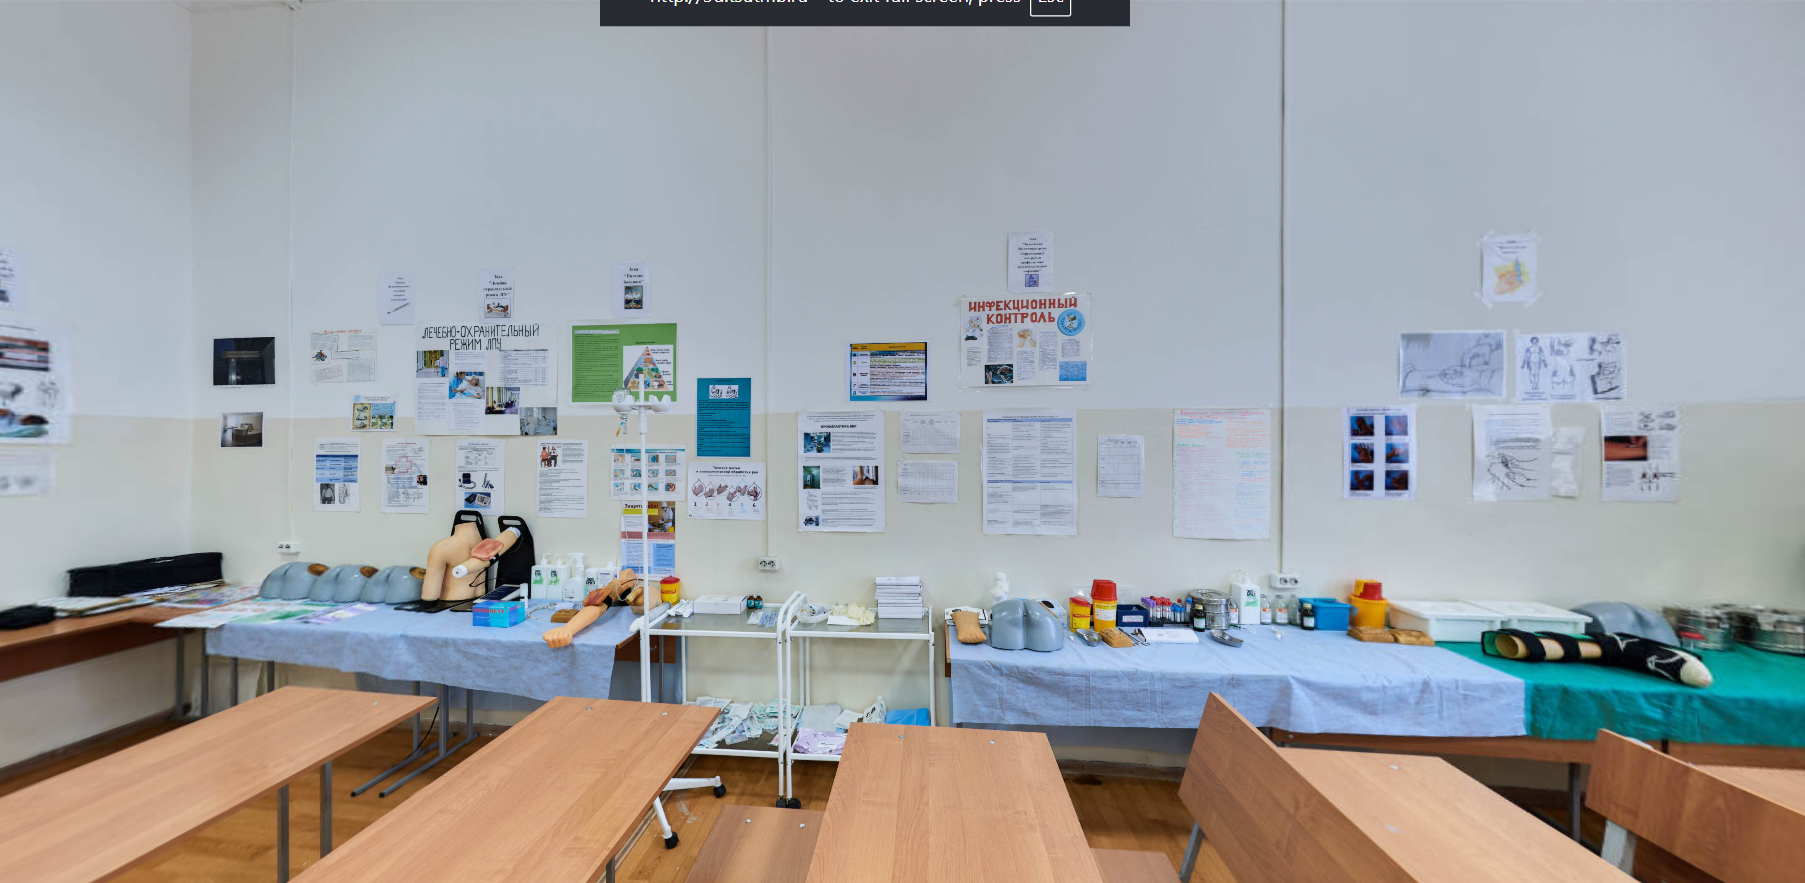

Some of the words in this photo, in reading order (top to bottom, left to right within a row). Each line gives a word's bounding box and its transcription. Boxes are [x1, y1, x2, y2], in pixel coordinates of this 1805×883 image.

[968, 296, 1078, 312] ИНФЕКЦИОННЫЙ
[986, 312, 1056, 324] КОНТРОЛЬ
[422, 324, 540, 339] ЛЕЧЕБНО-ОХРАНИТЕЛЬНЫЙ
[449, 338, 482, 350] РЕЖИМ
[486, 338, 502, 350] ЛПУ
